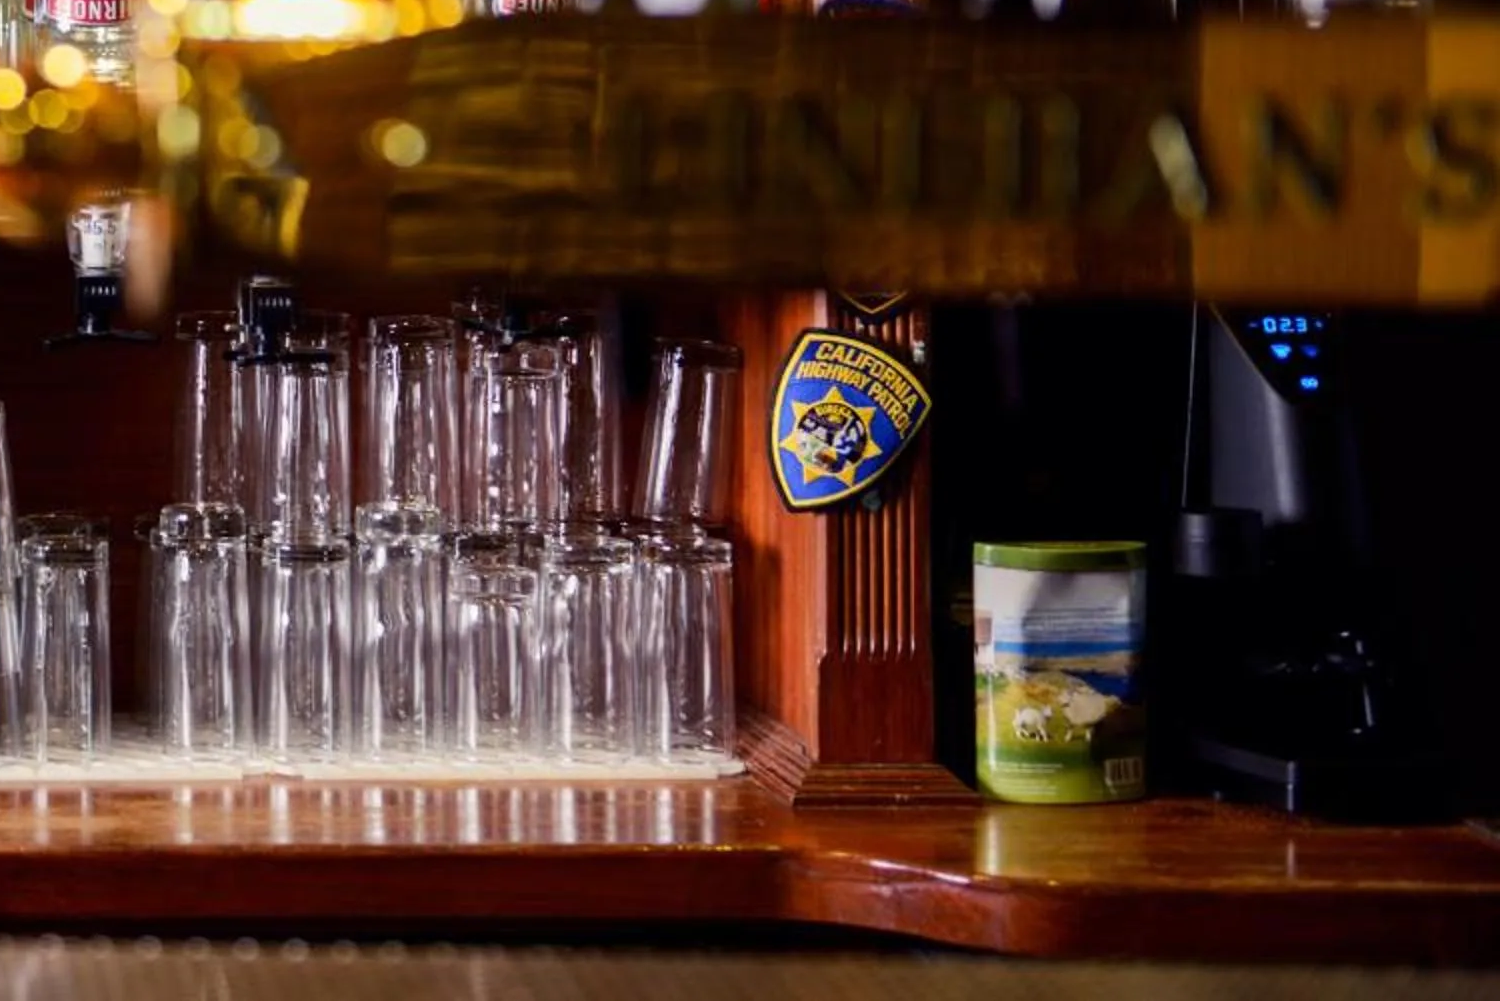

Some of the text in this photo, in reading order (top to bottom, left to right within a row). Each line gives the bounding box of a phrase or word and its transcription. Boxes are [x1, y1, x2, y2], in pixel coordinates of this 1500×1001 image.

[795, 360, 914, 440] HIGHWAY PATROL
[816, 341, 920, 412] CALIFORNIA
